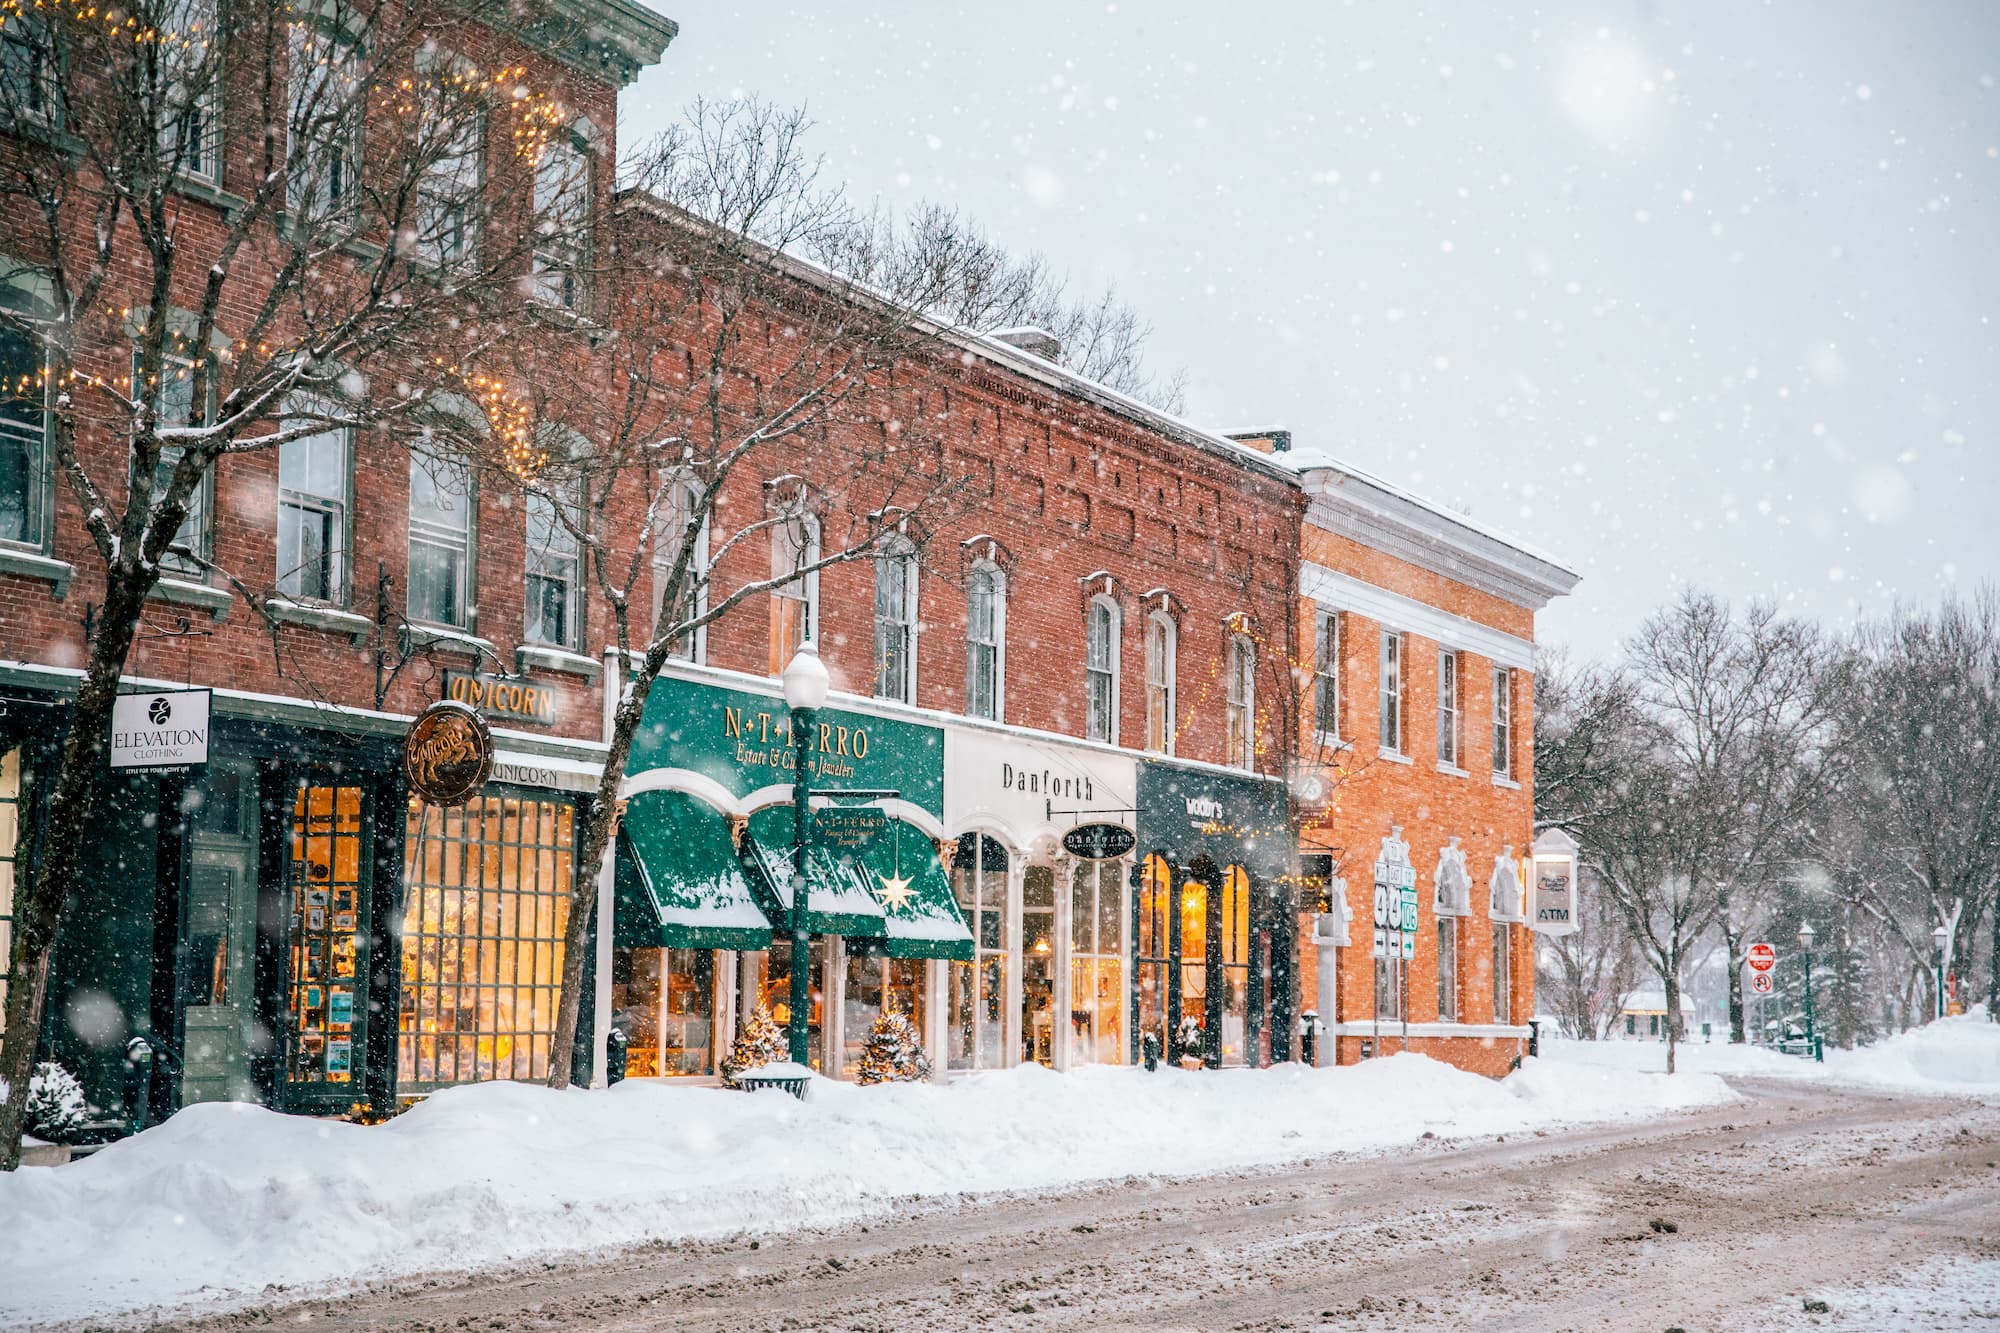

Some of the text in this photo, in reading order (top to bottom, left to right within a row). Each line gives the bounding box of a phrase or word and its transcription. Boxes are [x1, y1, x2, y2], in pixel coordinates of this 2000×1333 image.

[452, 676, 553, 716] UNICORN
[114, 729, 204, 749] ELEVATION
[134, 748, 183, 760] CLOTHING
[736, 742, 855, 779] Estate & Cum Jewelers
[494, 763, 558, 786] UNICORN
[1003, 763, 1093, 801] Danforth
[1068, 834, 1130, 845] Danforth
[1377, 895, 1384, 915] 4
[1392, 897, 1398, 916] 4
[1540, 909, 1569, 921] ATM
[1403, 905, 1416, 928] 106
